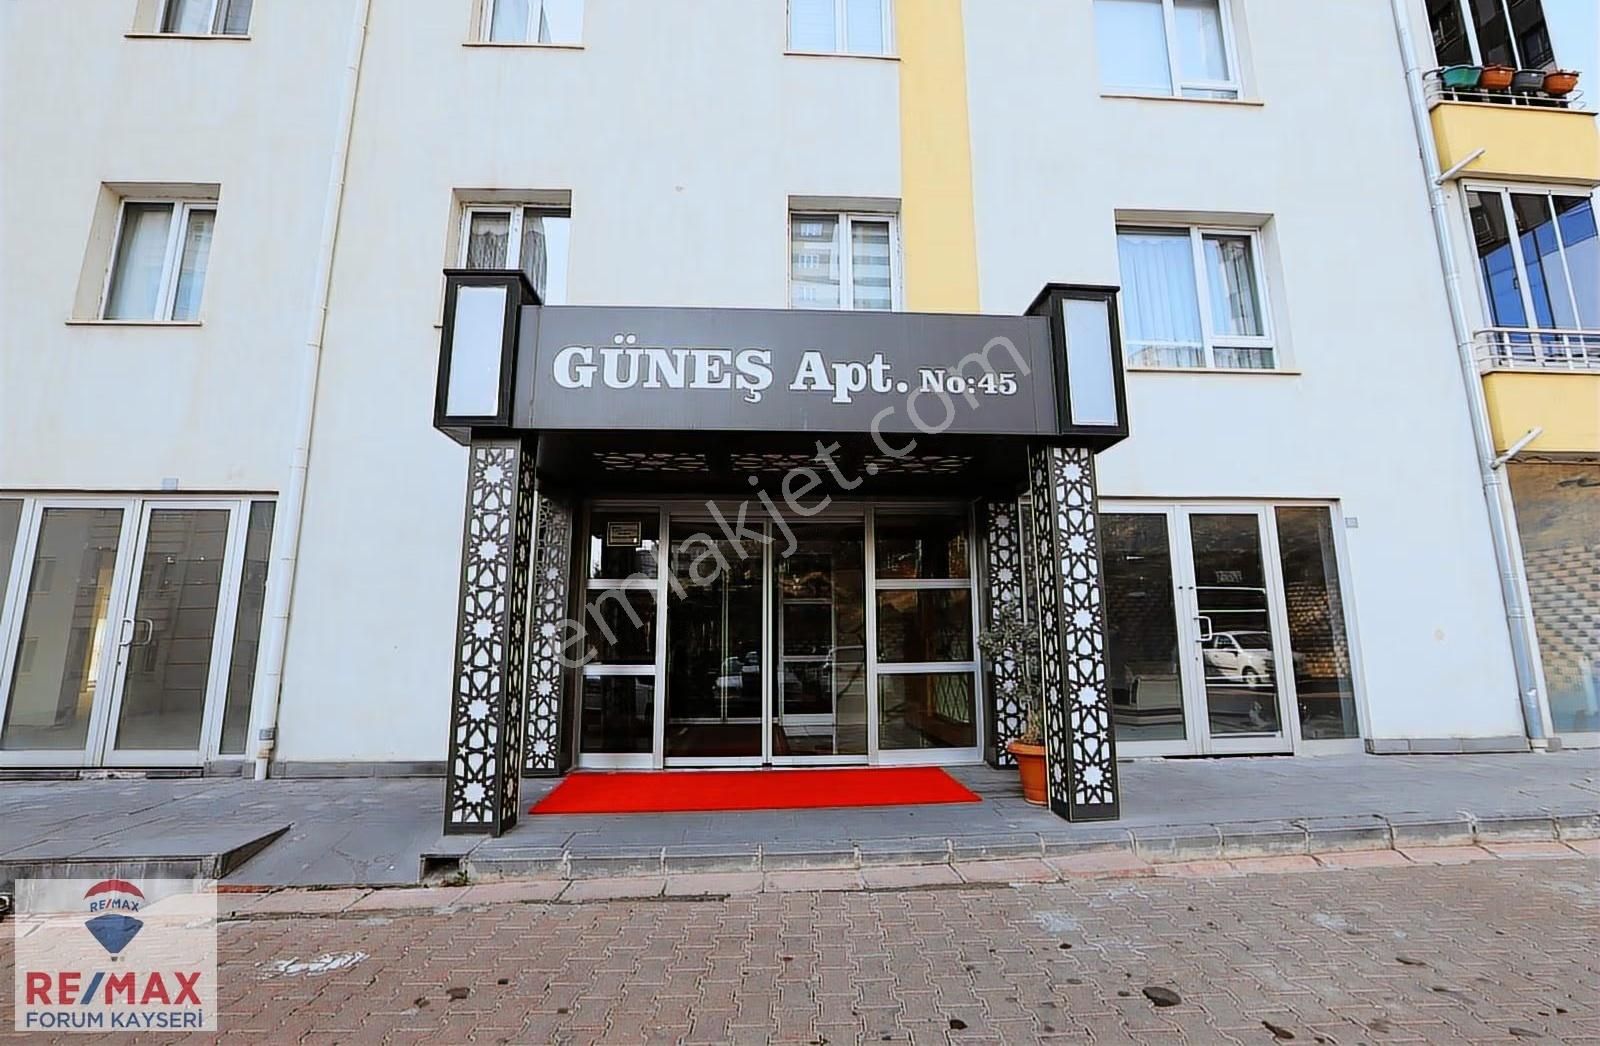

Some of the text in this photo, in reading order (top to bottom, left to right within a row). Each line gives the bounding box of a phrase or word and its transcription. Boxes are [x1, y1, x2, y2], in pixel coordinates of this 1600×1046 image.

[552, 334, 1018, 404] GÜNEŞ Apt. No:45
